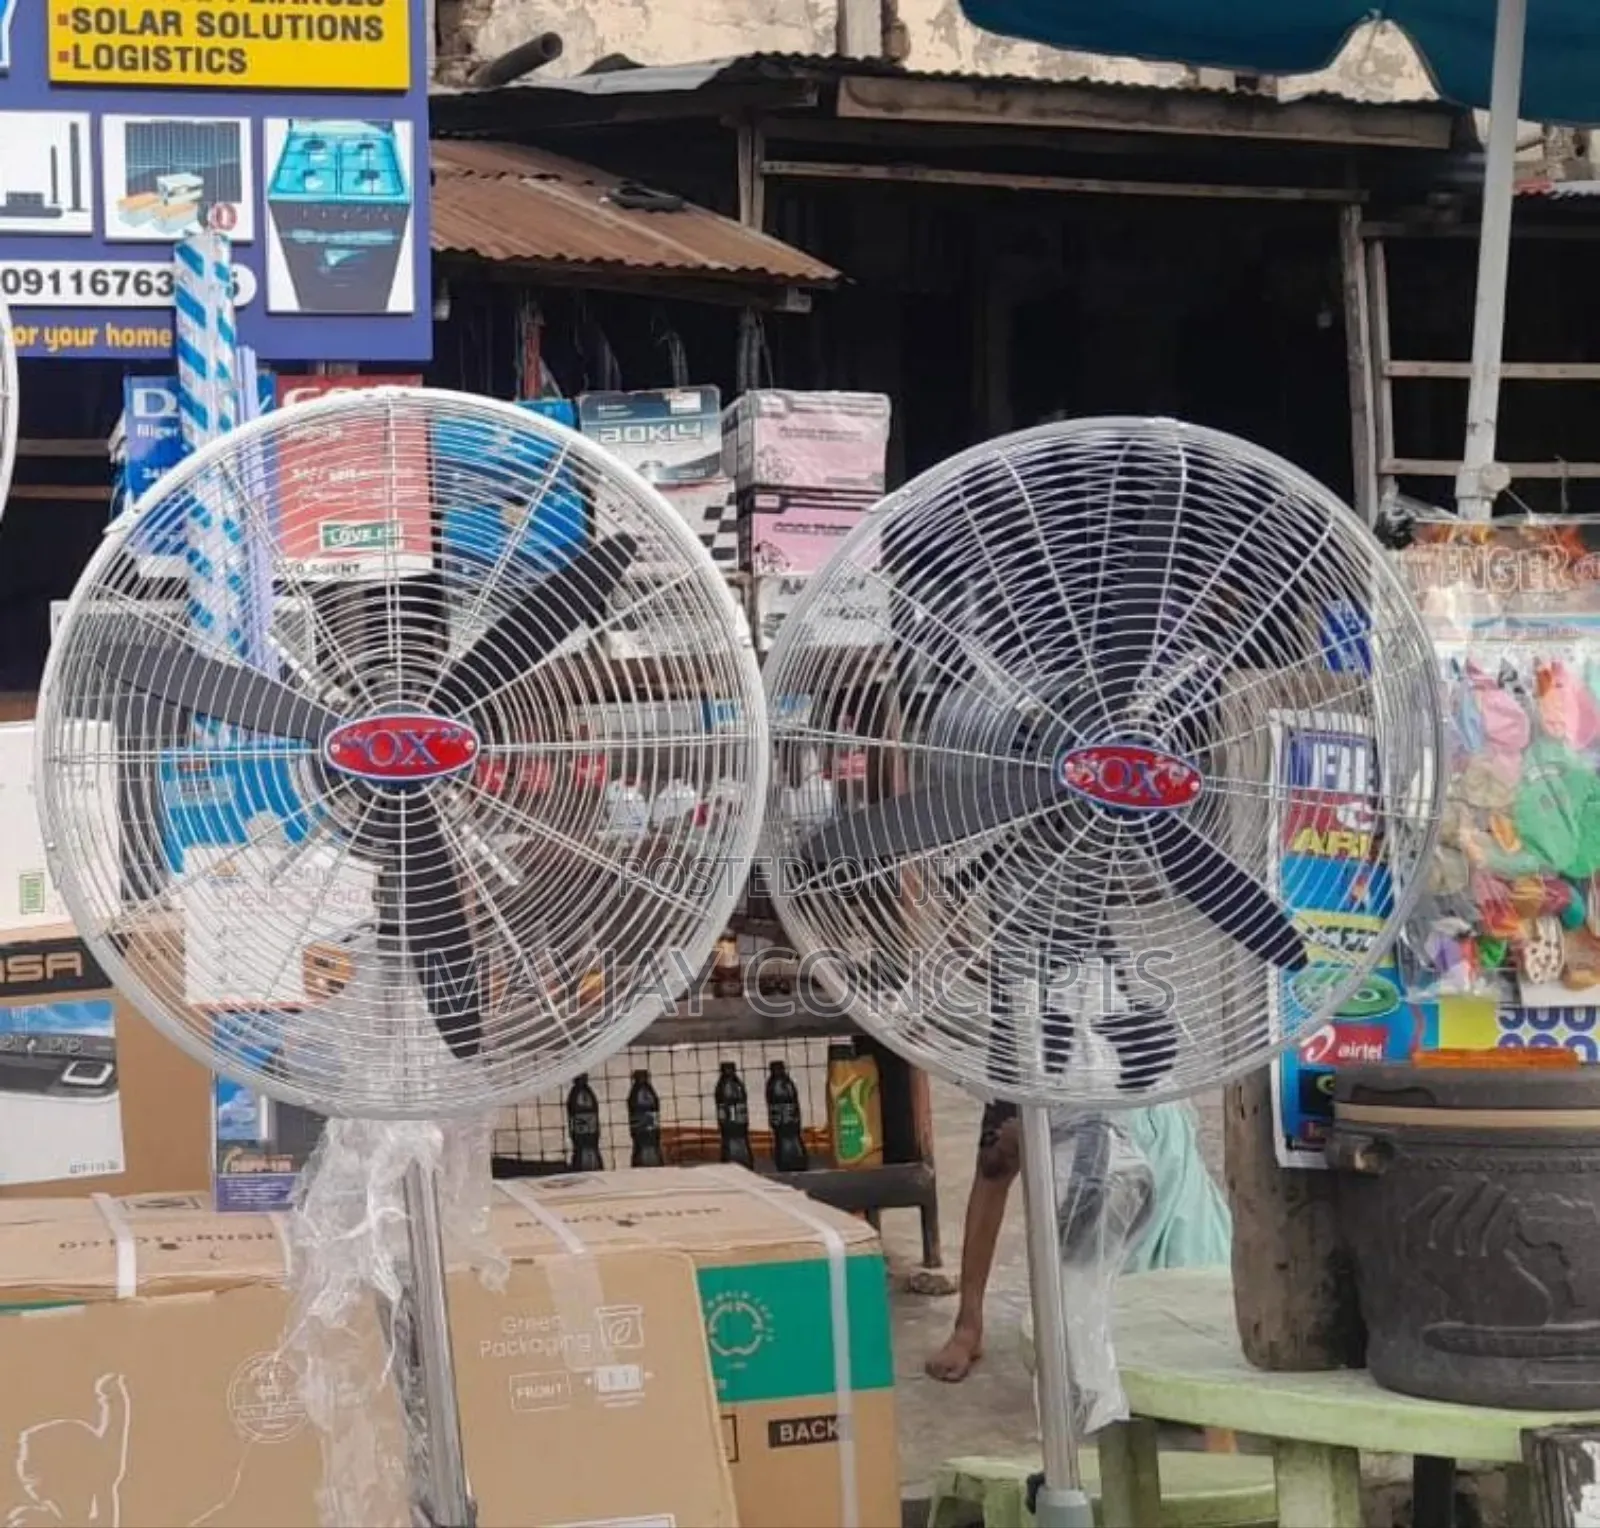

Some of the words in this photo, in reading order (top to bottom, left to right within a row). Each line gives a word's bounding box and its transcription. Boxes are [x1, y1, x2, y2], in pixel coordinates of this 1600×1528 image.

[71, 8, 183, 37] SOLAR
[196, 11, 384, 42] SOLUTIONS
[72, 43, 249, 75] LOGISTICS
[44, 325, 98, 351] your
[106, 322, 172, 349] home
[1337, 1040, 1383, 1061] airtel
[778, 1419, 841, 1443] BACK
